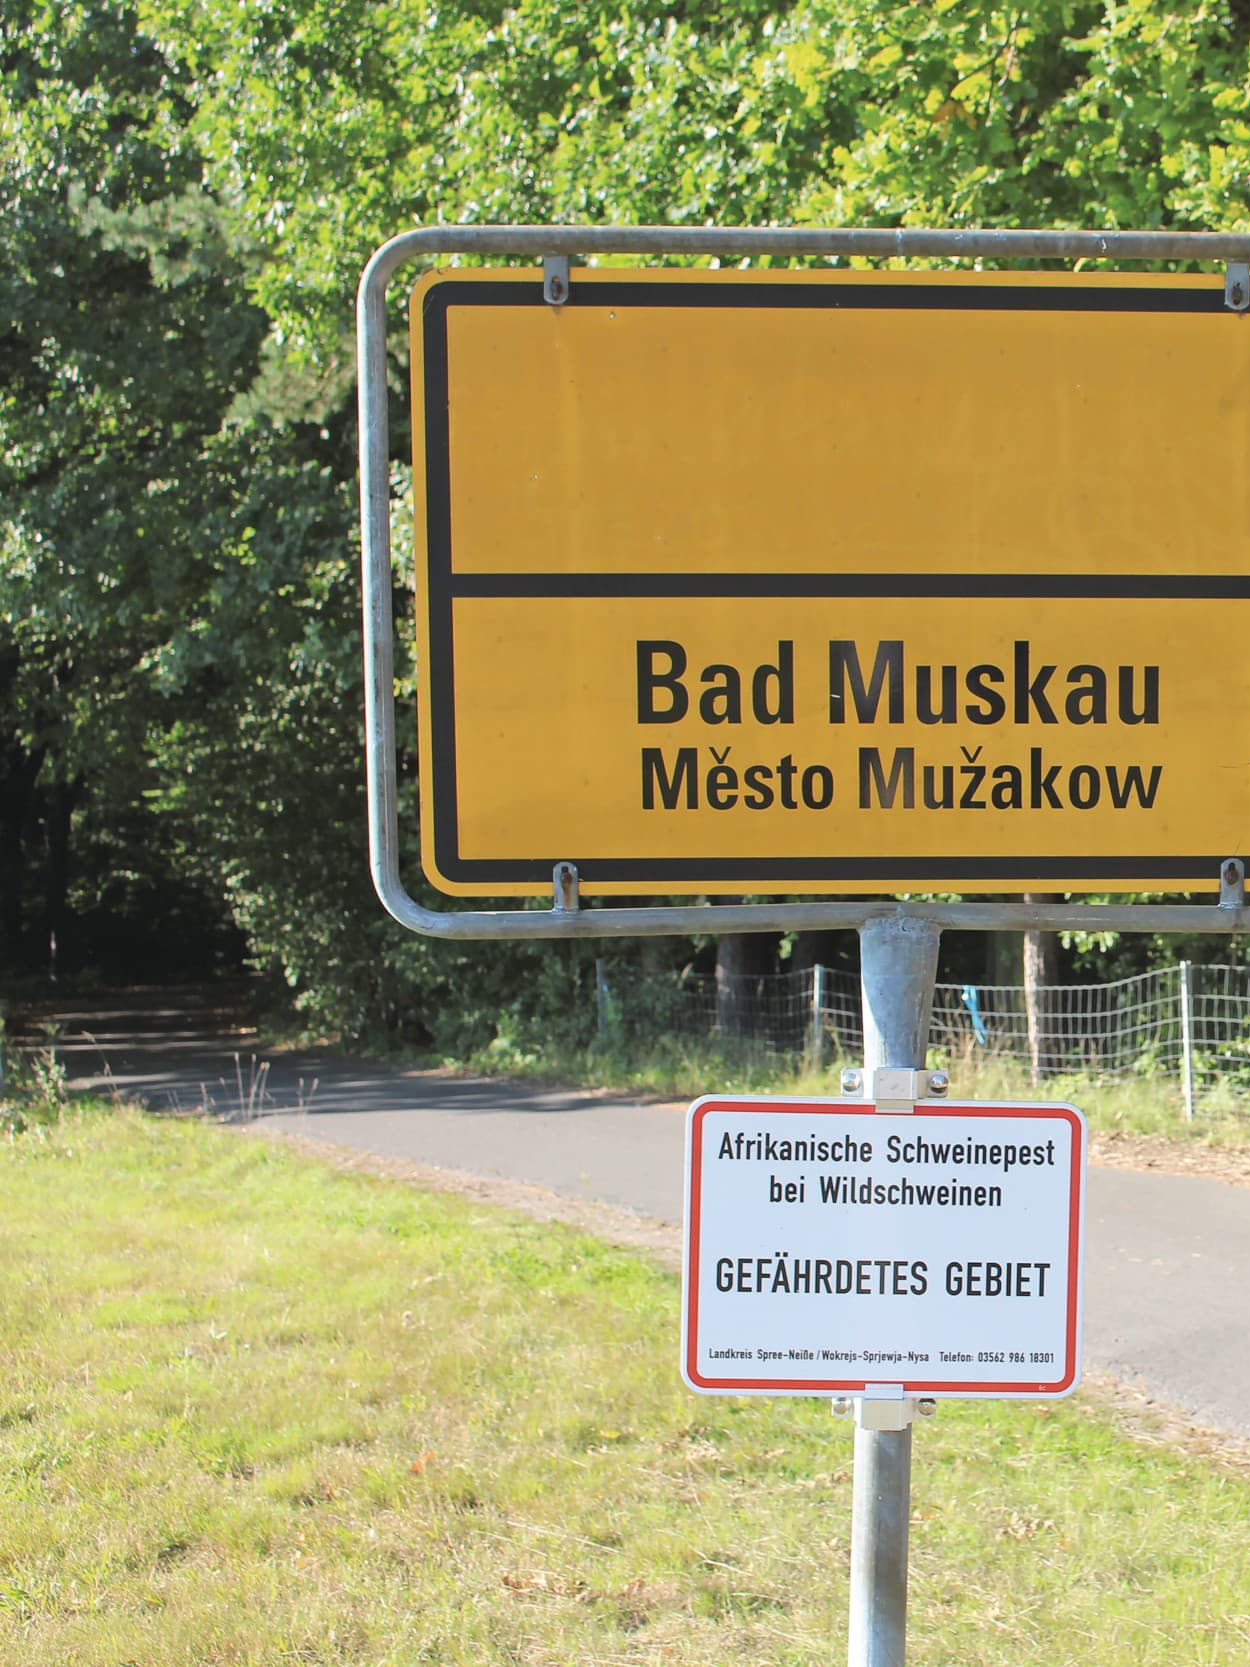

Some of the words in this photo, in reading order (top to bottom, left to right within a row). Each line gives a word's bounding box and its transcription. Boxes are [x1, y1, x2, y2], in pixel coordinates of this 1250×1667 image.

[636, 640, 794, 725] Bad
[829, 640, 1160, 725] Muskau
[641, 746, 834, 811] Město
[858, 745, 1163, 811] Mužakow
[718, 1131, 873, 1163] Afrikanische
[886, 1135, 1055, 1173] Schweinepest
[769, 1174, 805, 1203] bei
[819, 1175, 1002, 1207] Wildschweinen
[716, 1251, 928, 1296] GEFÄHRDETES
[945, 1261, 1051, 1297] GEBIET
[709, 1348, 753, 1360] Landkreis
[939, 1351, 974, 1363] Telefon:
[978, 1352, 1005, 1363] 03562
[1009, 1352, 1025, 1363] 986
[1030, 1352, 1054, 1364] 18301
